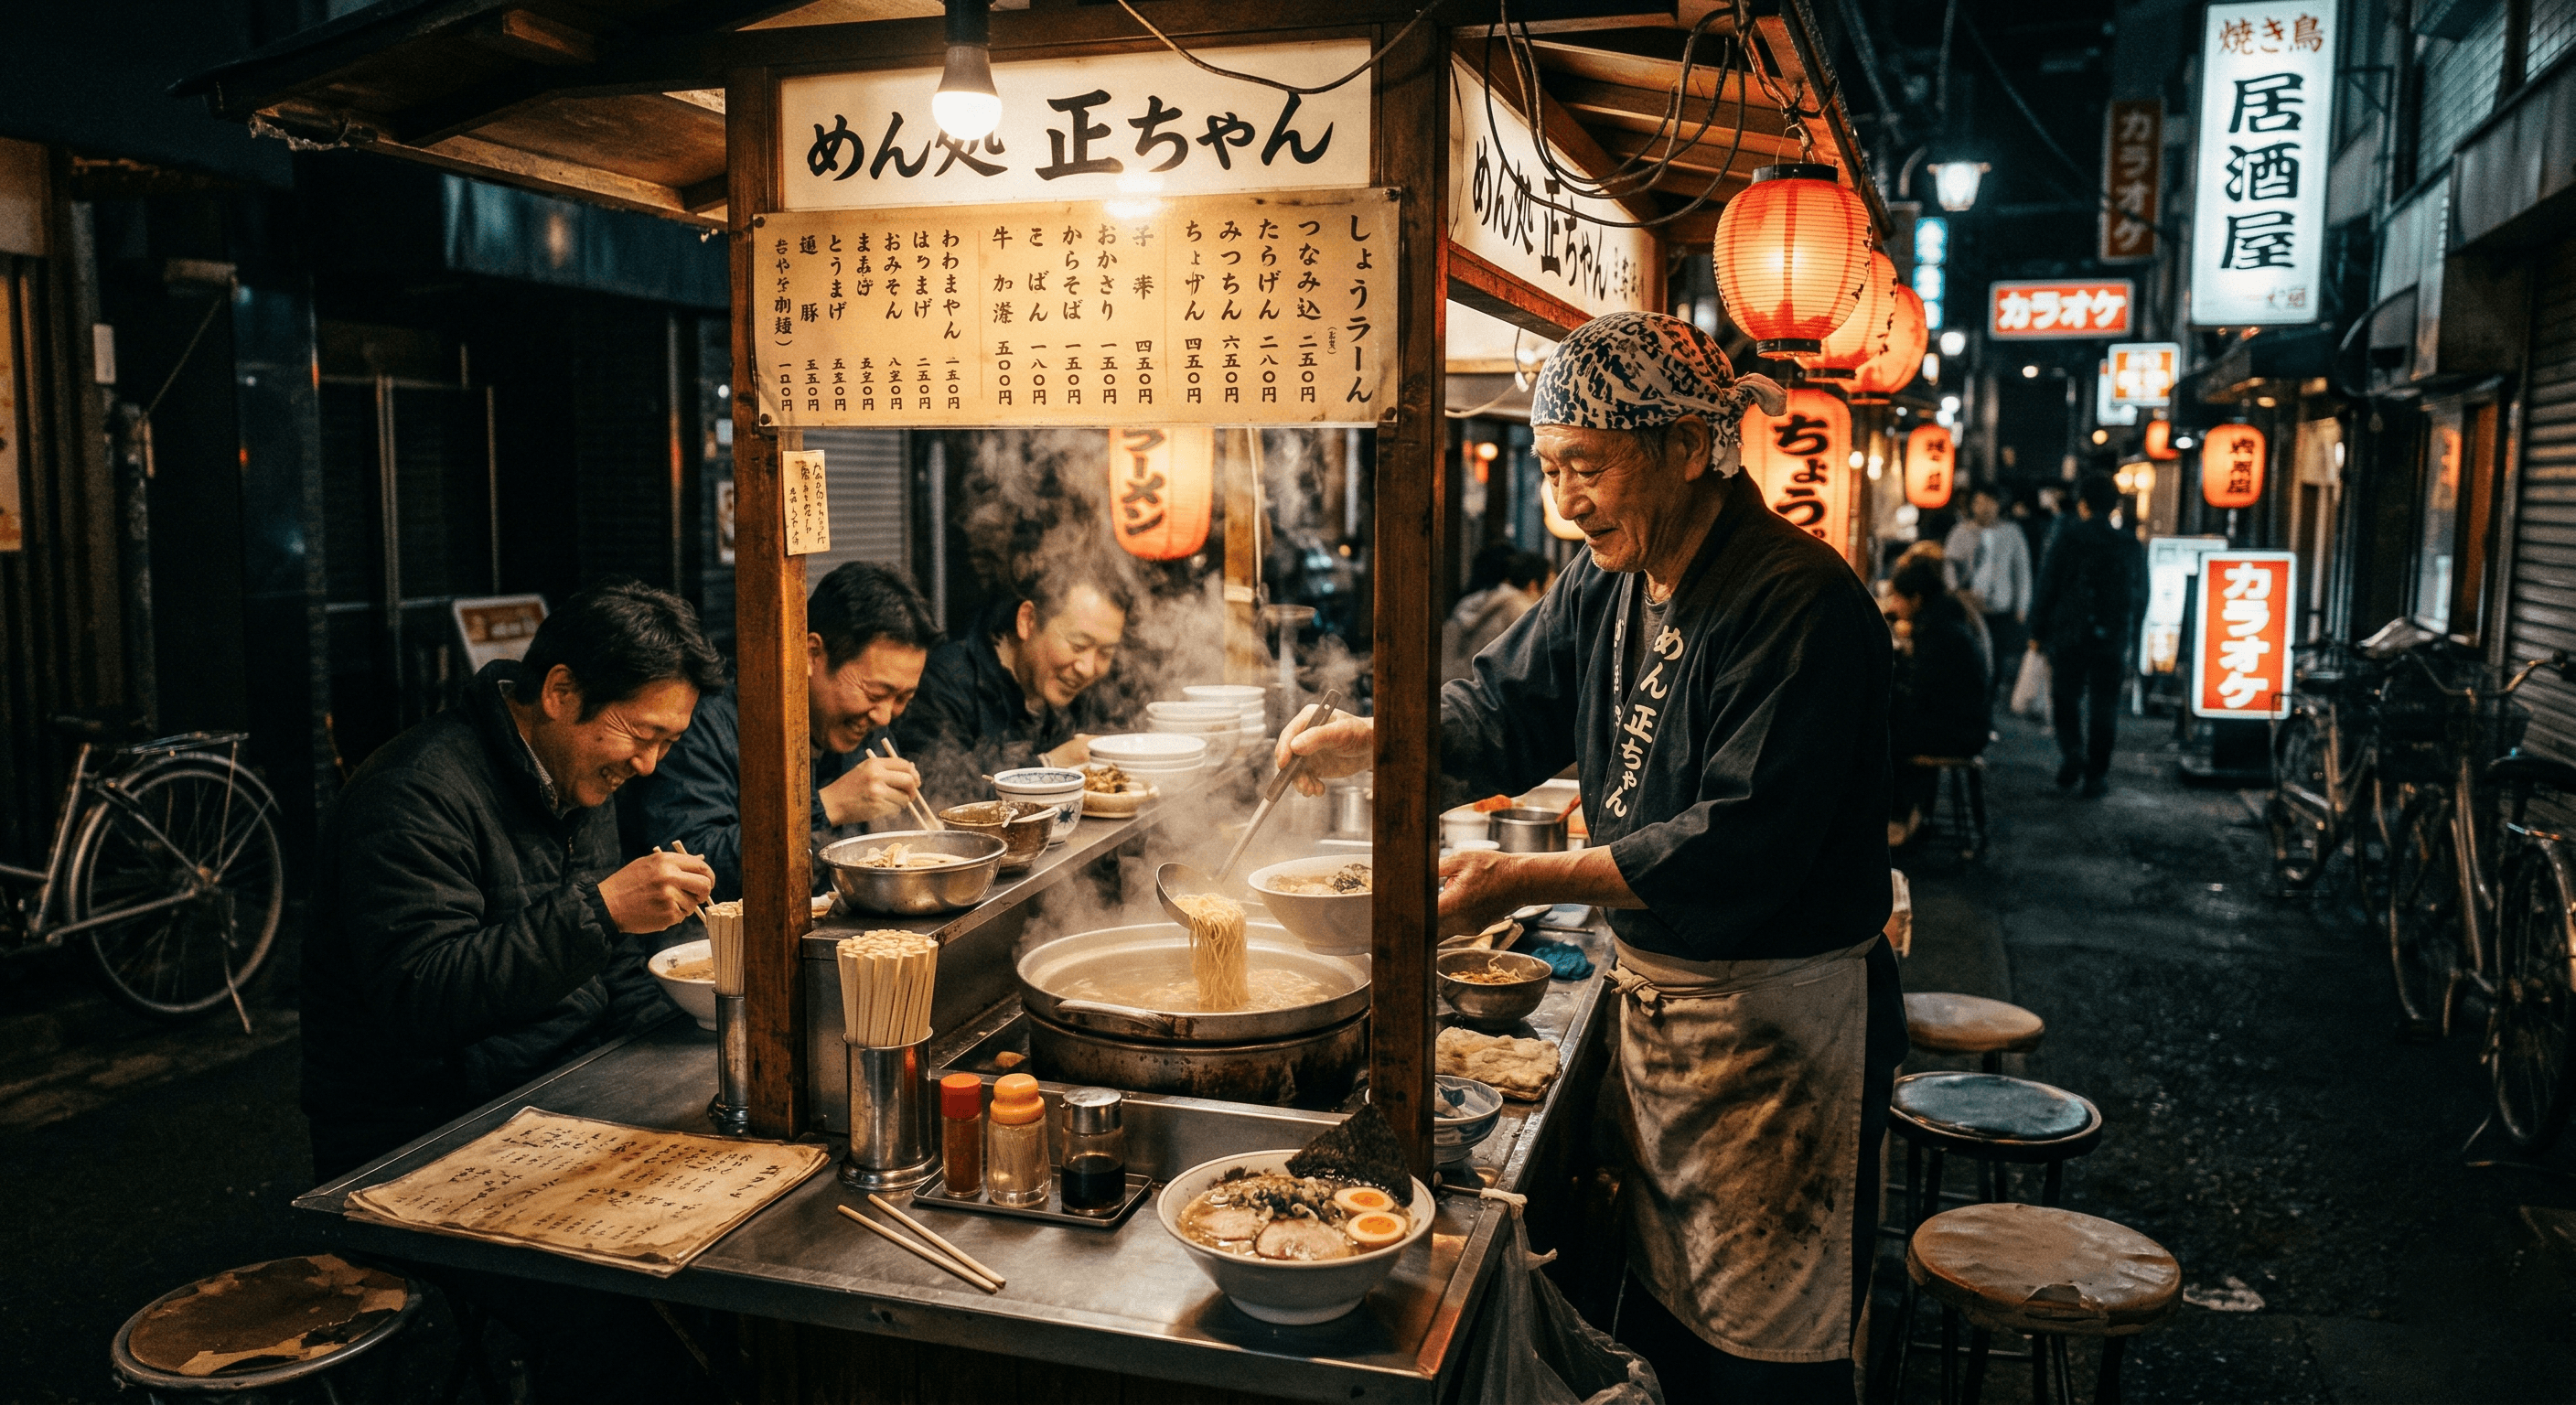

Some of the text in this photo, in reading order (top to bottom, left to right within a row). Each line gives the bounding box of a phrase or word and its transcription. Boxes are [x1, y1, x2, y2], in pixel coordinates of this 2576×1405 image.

[2218, 14, 2324, 55] 焼き鳥
[1035, 89, 1334, 181] 正ちゃん
[2112, 110, 2152, 252] カラオケ
[2221, 72, 2304, 270] 居酒屋
[1999, 289, 2127, 329] カラオケ
[2217, 562, 2272, 709] カラオケ
